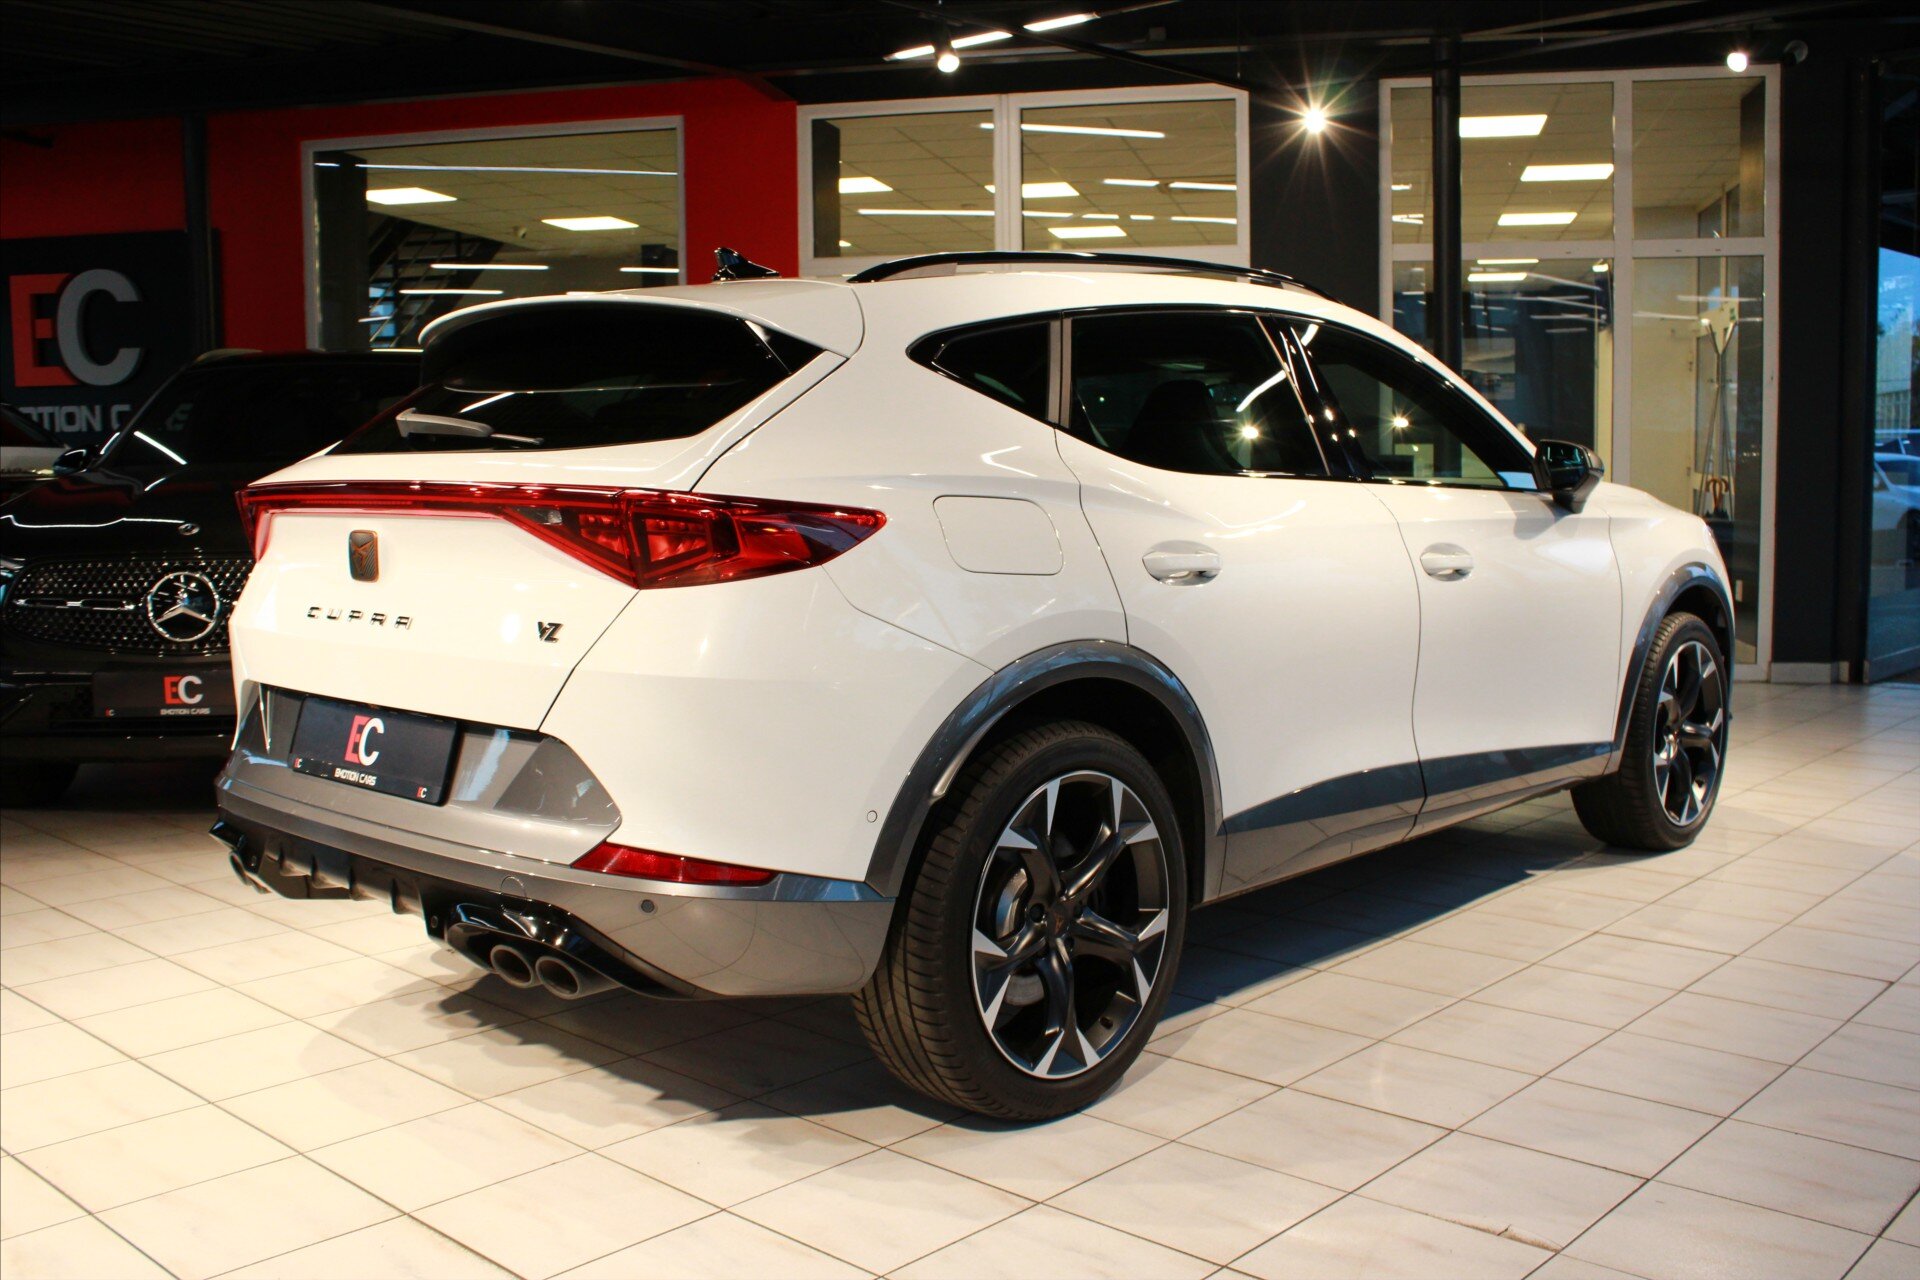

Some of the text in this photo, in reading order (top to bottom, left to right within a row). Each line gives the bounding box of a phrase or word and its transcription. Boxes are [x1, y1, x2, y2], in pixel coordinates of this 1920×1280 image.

[9, 268, 143, 388] EC
[307, 606, 413, 630] CUPRA
[537, 621, 564, 643] VZ
[163, 675, 204, 705] EC
[160, 707, 210, 716] EMOTION CARS
[344, 714, 385, 767] EC
[334, 767, 378, 786] EMOTION CARS
